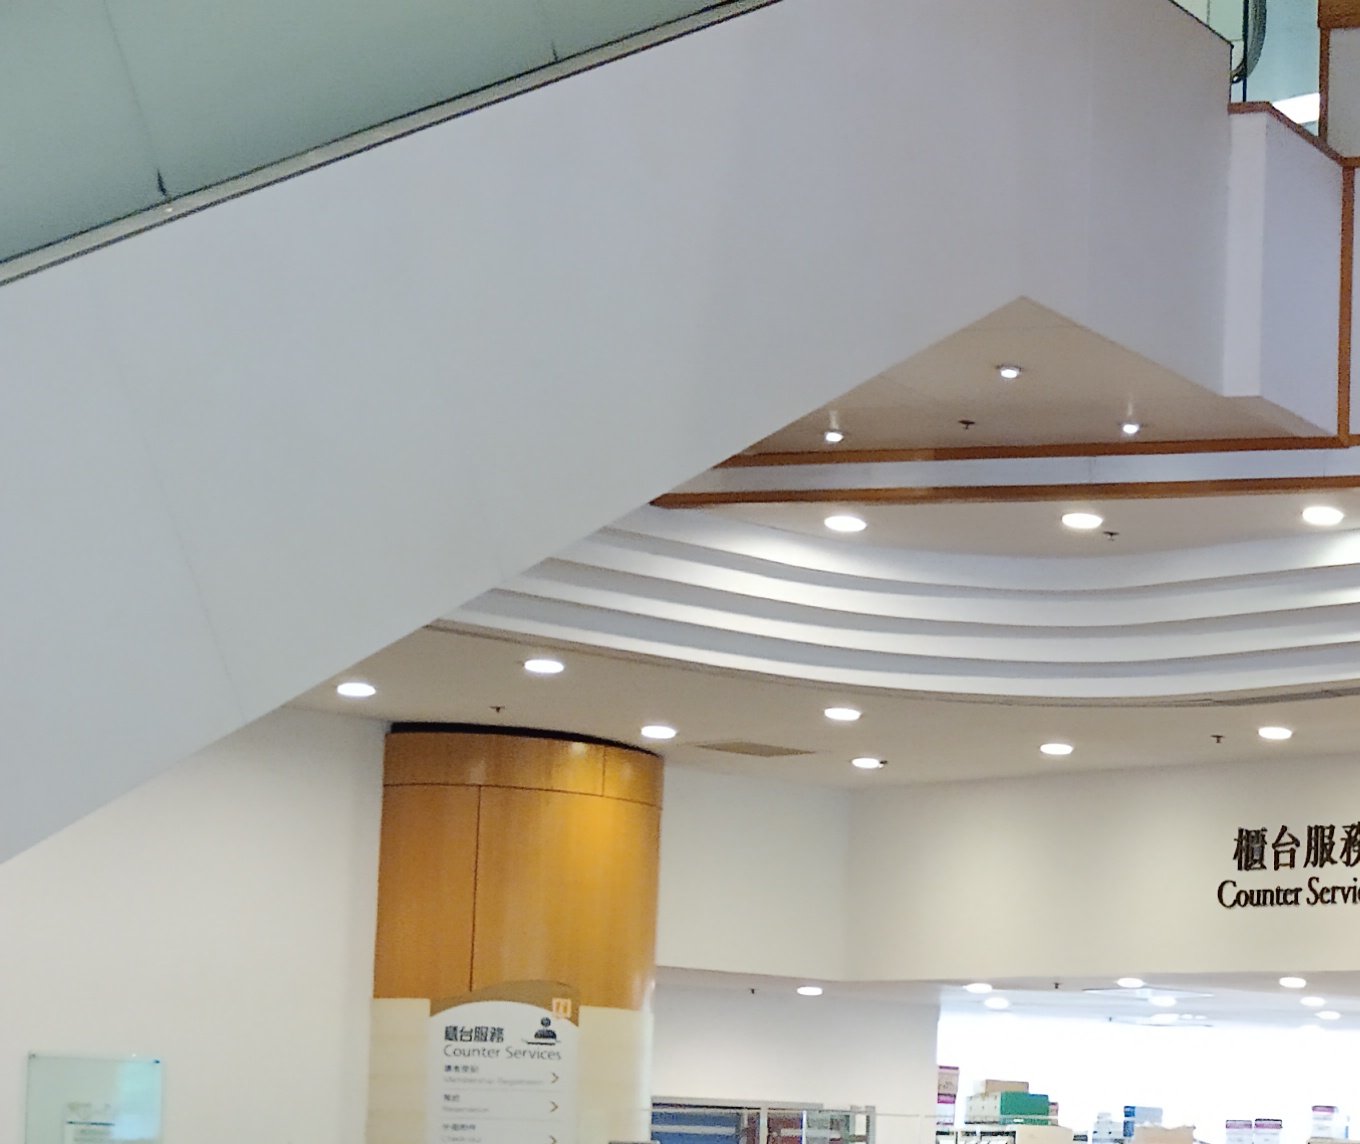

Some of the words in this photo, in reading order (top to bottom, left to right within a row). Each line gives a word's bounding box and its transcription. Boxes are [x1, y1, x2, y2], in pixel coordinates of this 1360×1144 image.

[1217, 880, 1303, 909] Counter
[444, 1025, 505, 1043] 櫃台服務
[443, 1044, 501, 1059] Counter
[505, 1046, 562, 1061] Services
